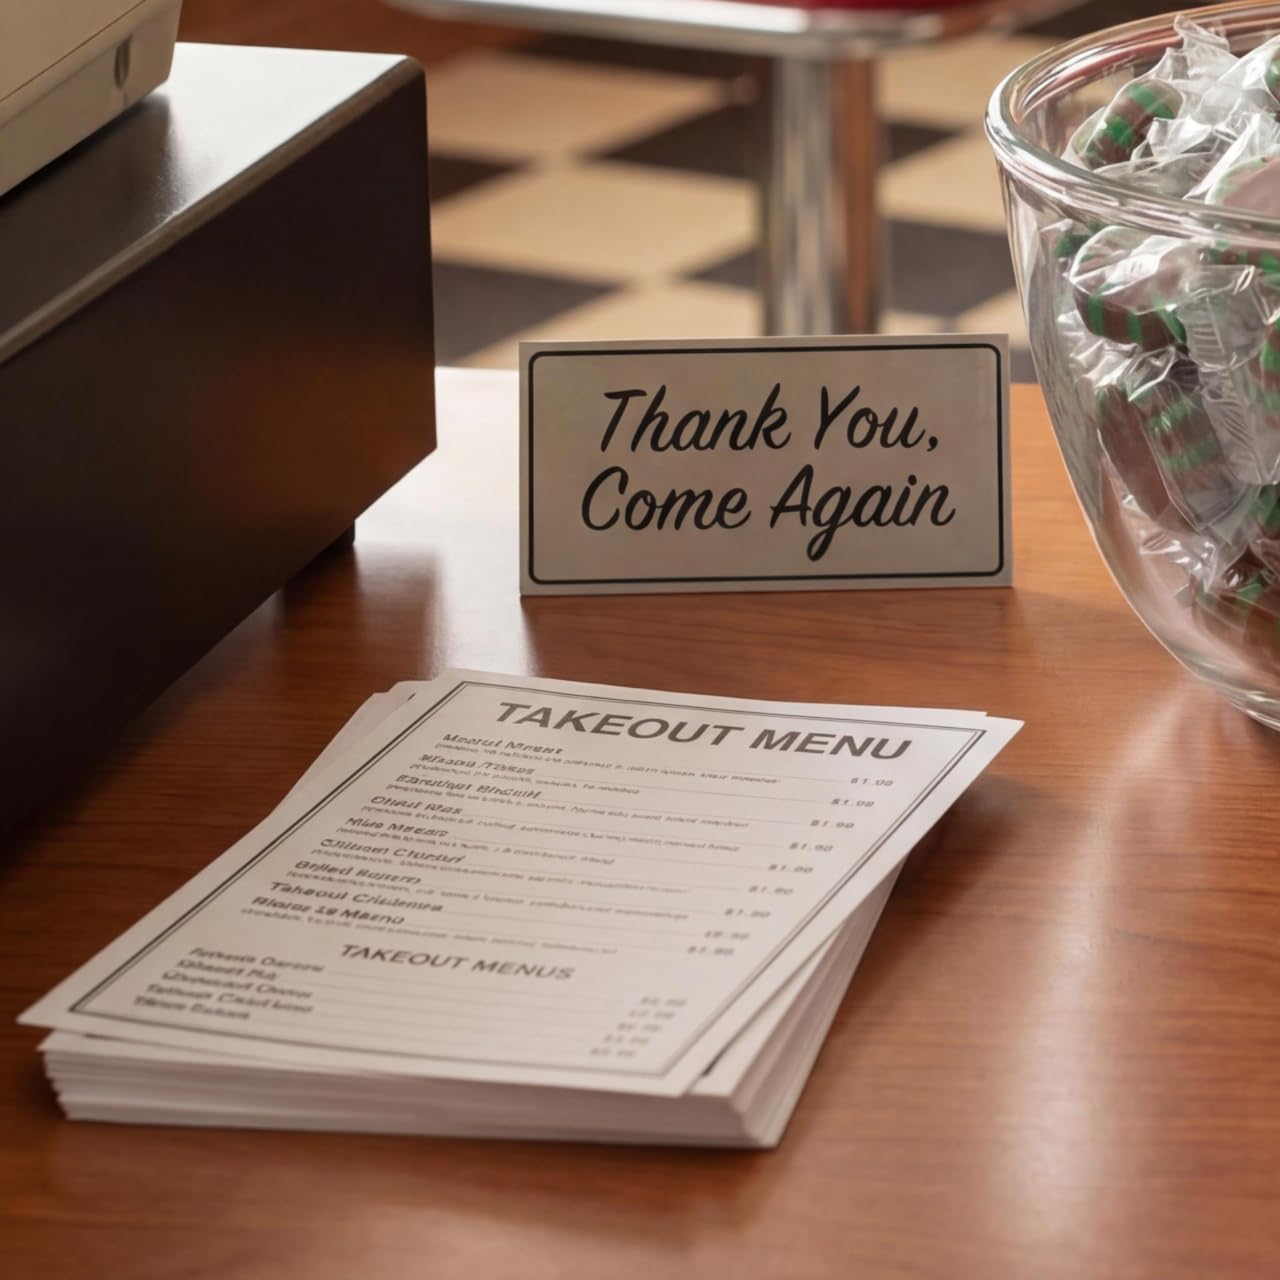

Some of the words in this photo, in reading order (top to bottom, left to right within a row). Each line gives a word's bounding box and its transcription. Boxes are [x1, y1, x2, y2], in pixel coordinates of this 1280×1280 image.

[600, 383, 791, 452] Thank
[813, 385, 939, 452] You,
[581, 466, 751, 531] Come
[770, 464, 956, 561] Again
[496, 701, 744, 746] TAKEOUT
[749, 729, 912, 760] MENU
[339, 944, 470, 969] TAKEOUT
[471, 959, 576, 980] MENUS
